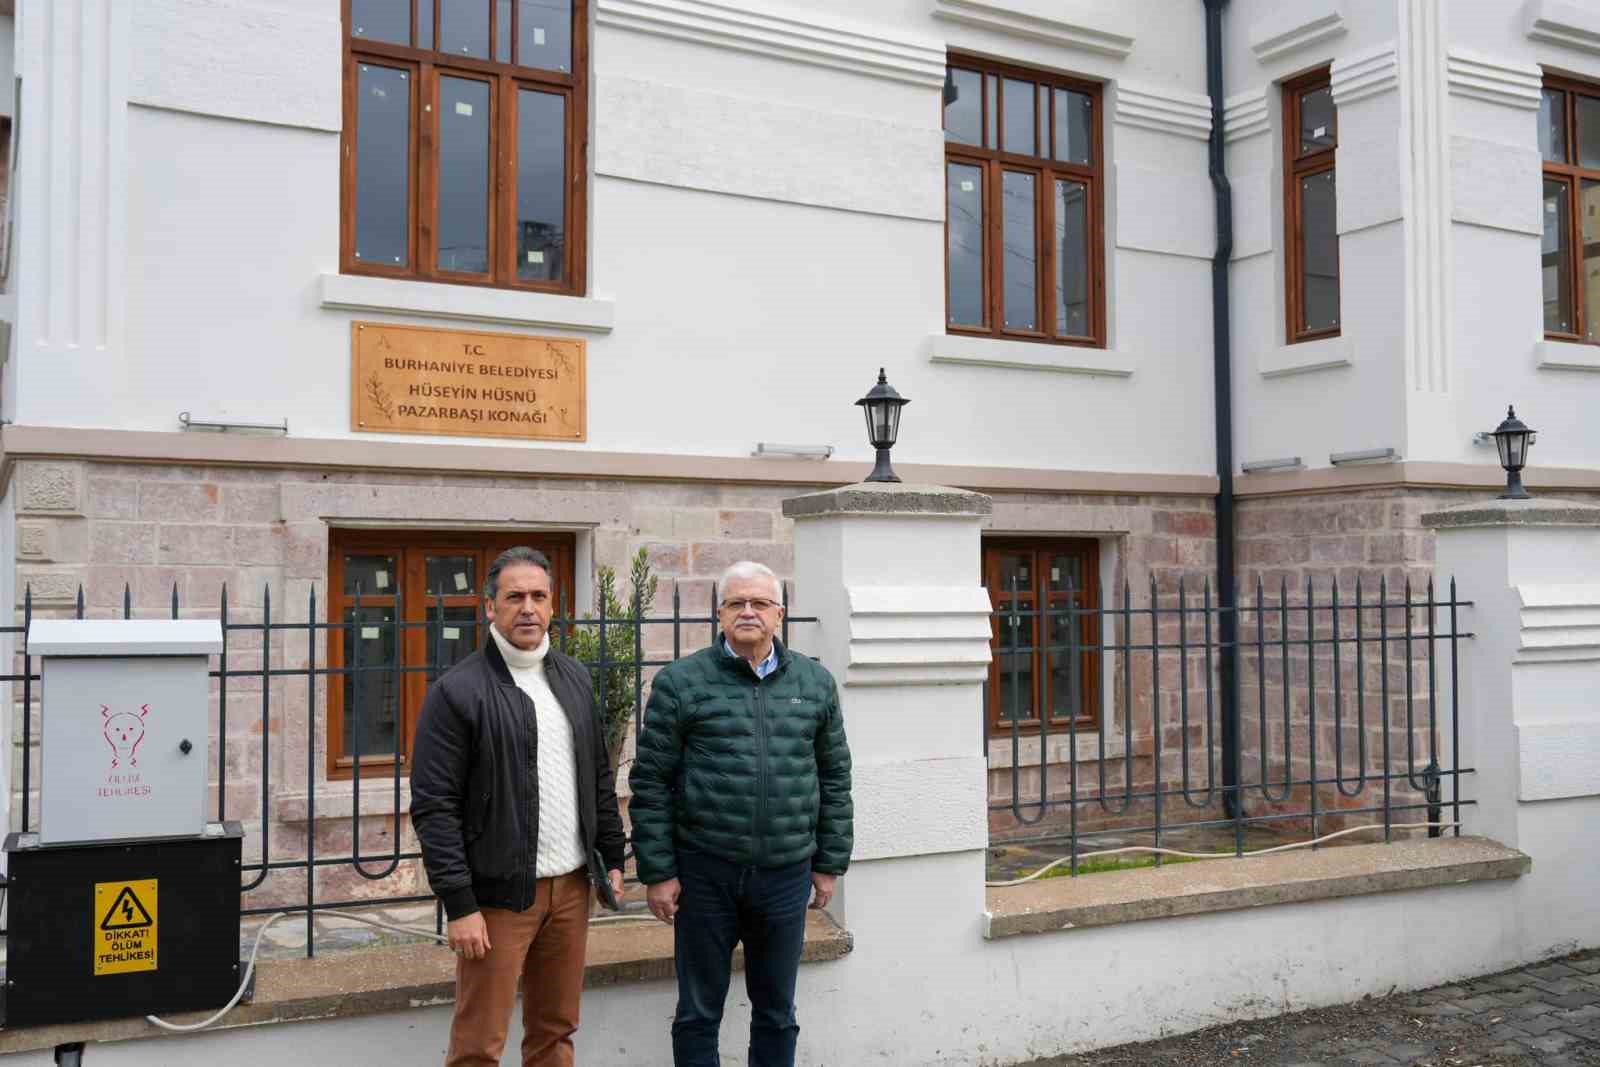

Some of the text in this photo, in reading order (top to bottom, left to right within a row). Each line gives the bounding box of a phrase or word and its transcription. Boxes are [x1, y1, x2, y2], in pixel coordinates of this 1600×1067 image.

[384, 357, 559, 380] BURHANİYE BELEDİYESİ
[408, 382, 537, 404] HÜSEYİN HÜSNÜ
[397, 404, 548, 424] PAZARBAŞI KONAĞI
[112, 940, 142, 951] ÖLÜM
